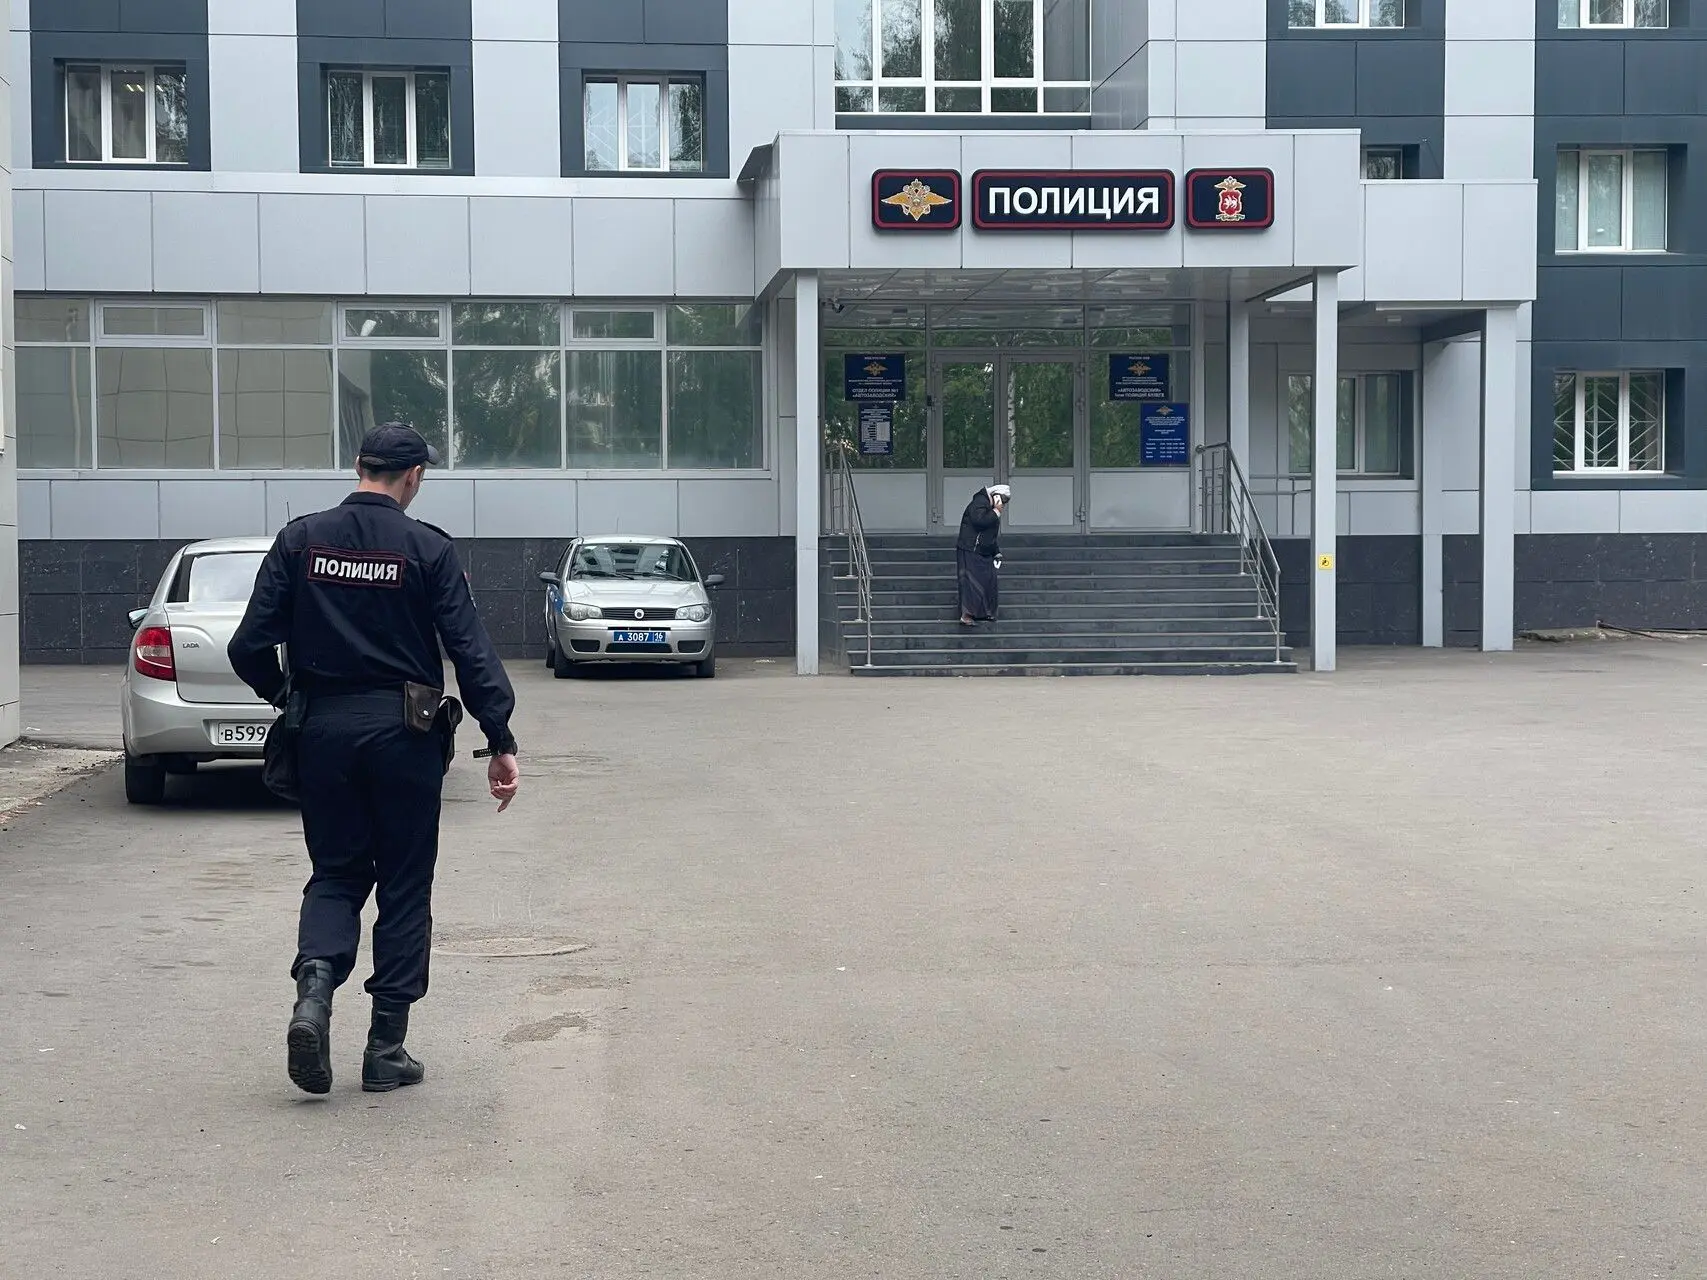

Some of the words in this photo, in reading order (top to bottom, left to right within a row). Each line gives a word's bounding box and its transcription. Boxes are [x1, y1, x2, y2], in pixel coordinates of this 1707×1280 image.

[988, 187, 1160, 220] ПОЛИЦИЯ
[314, 557, 398, 581] ПОЛИЦИЯ
[627, 632, 650, 642] 3087
